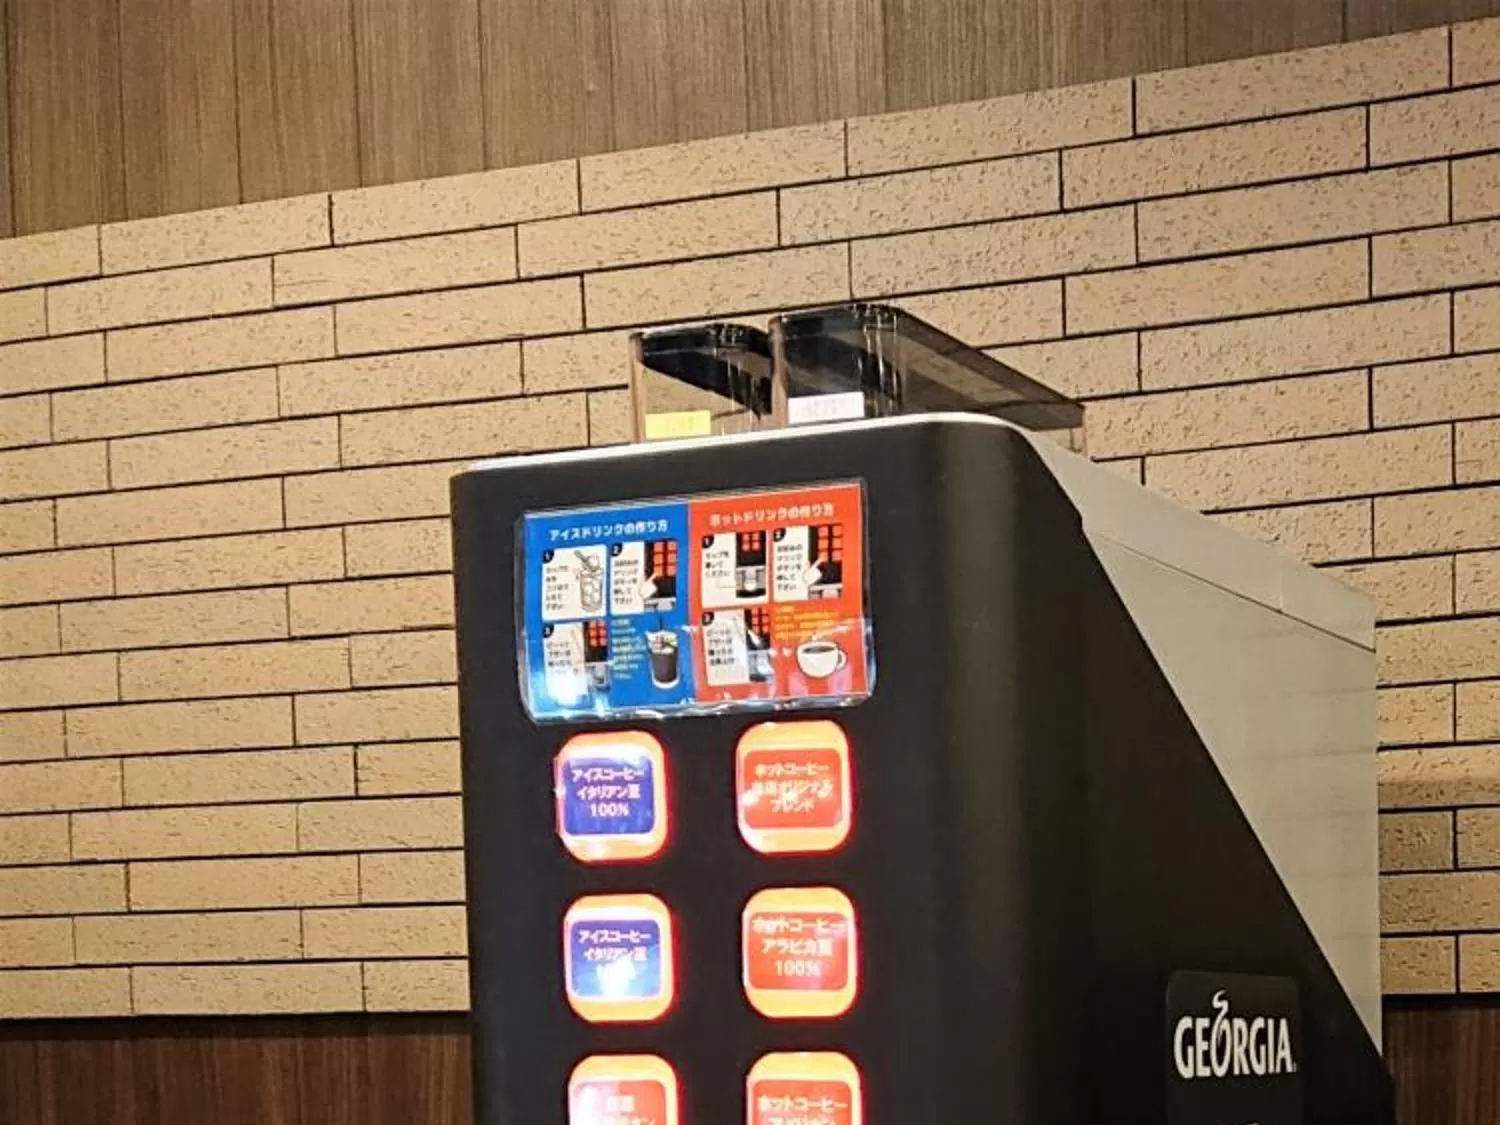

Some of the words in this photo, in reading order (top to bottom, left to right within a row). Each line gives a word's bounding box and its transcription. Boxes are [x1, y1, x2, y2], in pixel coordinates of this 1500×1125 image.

[571, 766, 644, 783] アイスコーヒー
[577, 783, 641, 800] イタリアン豆
[589, 802, 629, 817] 100%
[577, 928, 652, 945] アイスコーヒー
[776, 959, 821, 977] 100%
[1173, 989, 1293, 1079] GEORGIA
